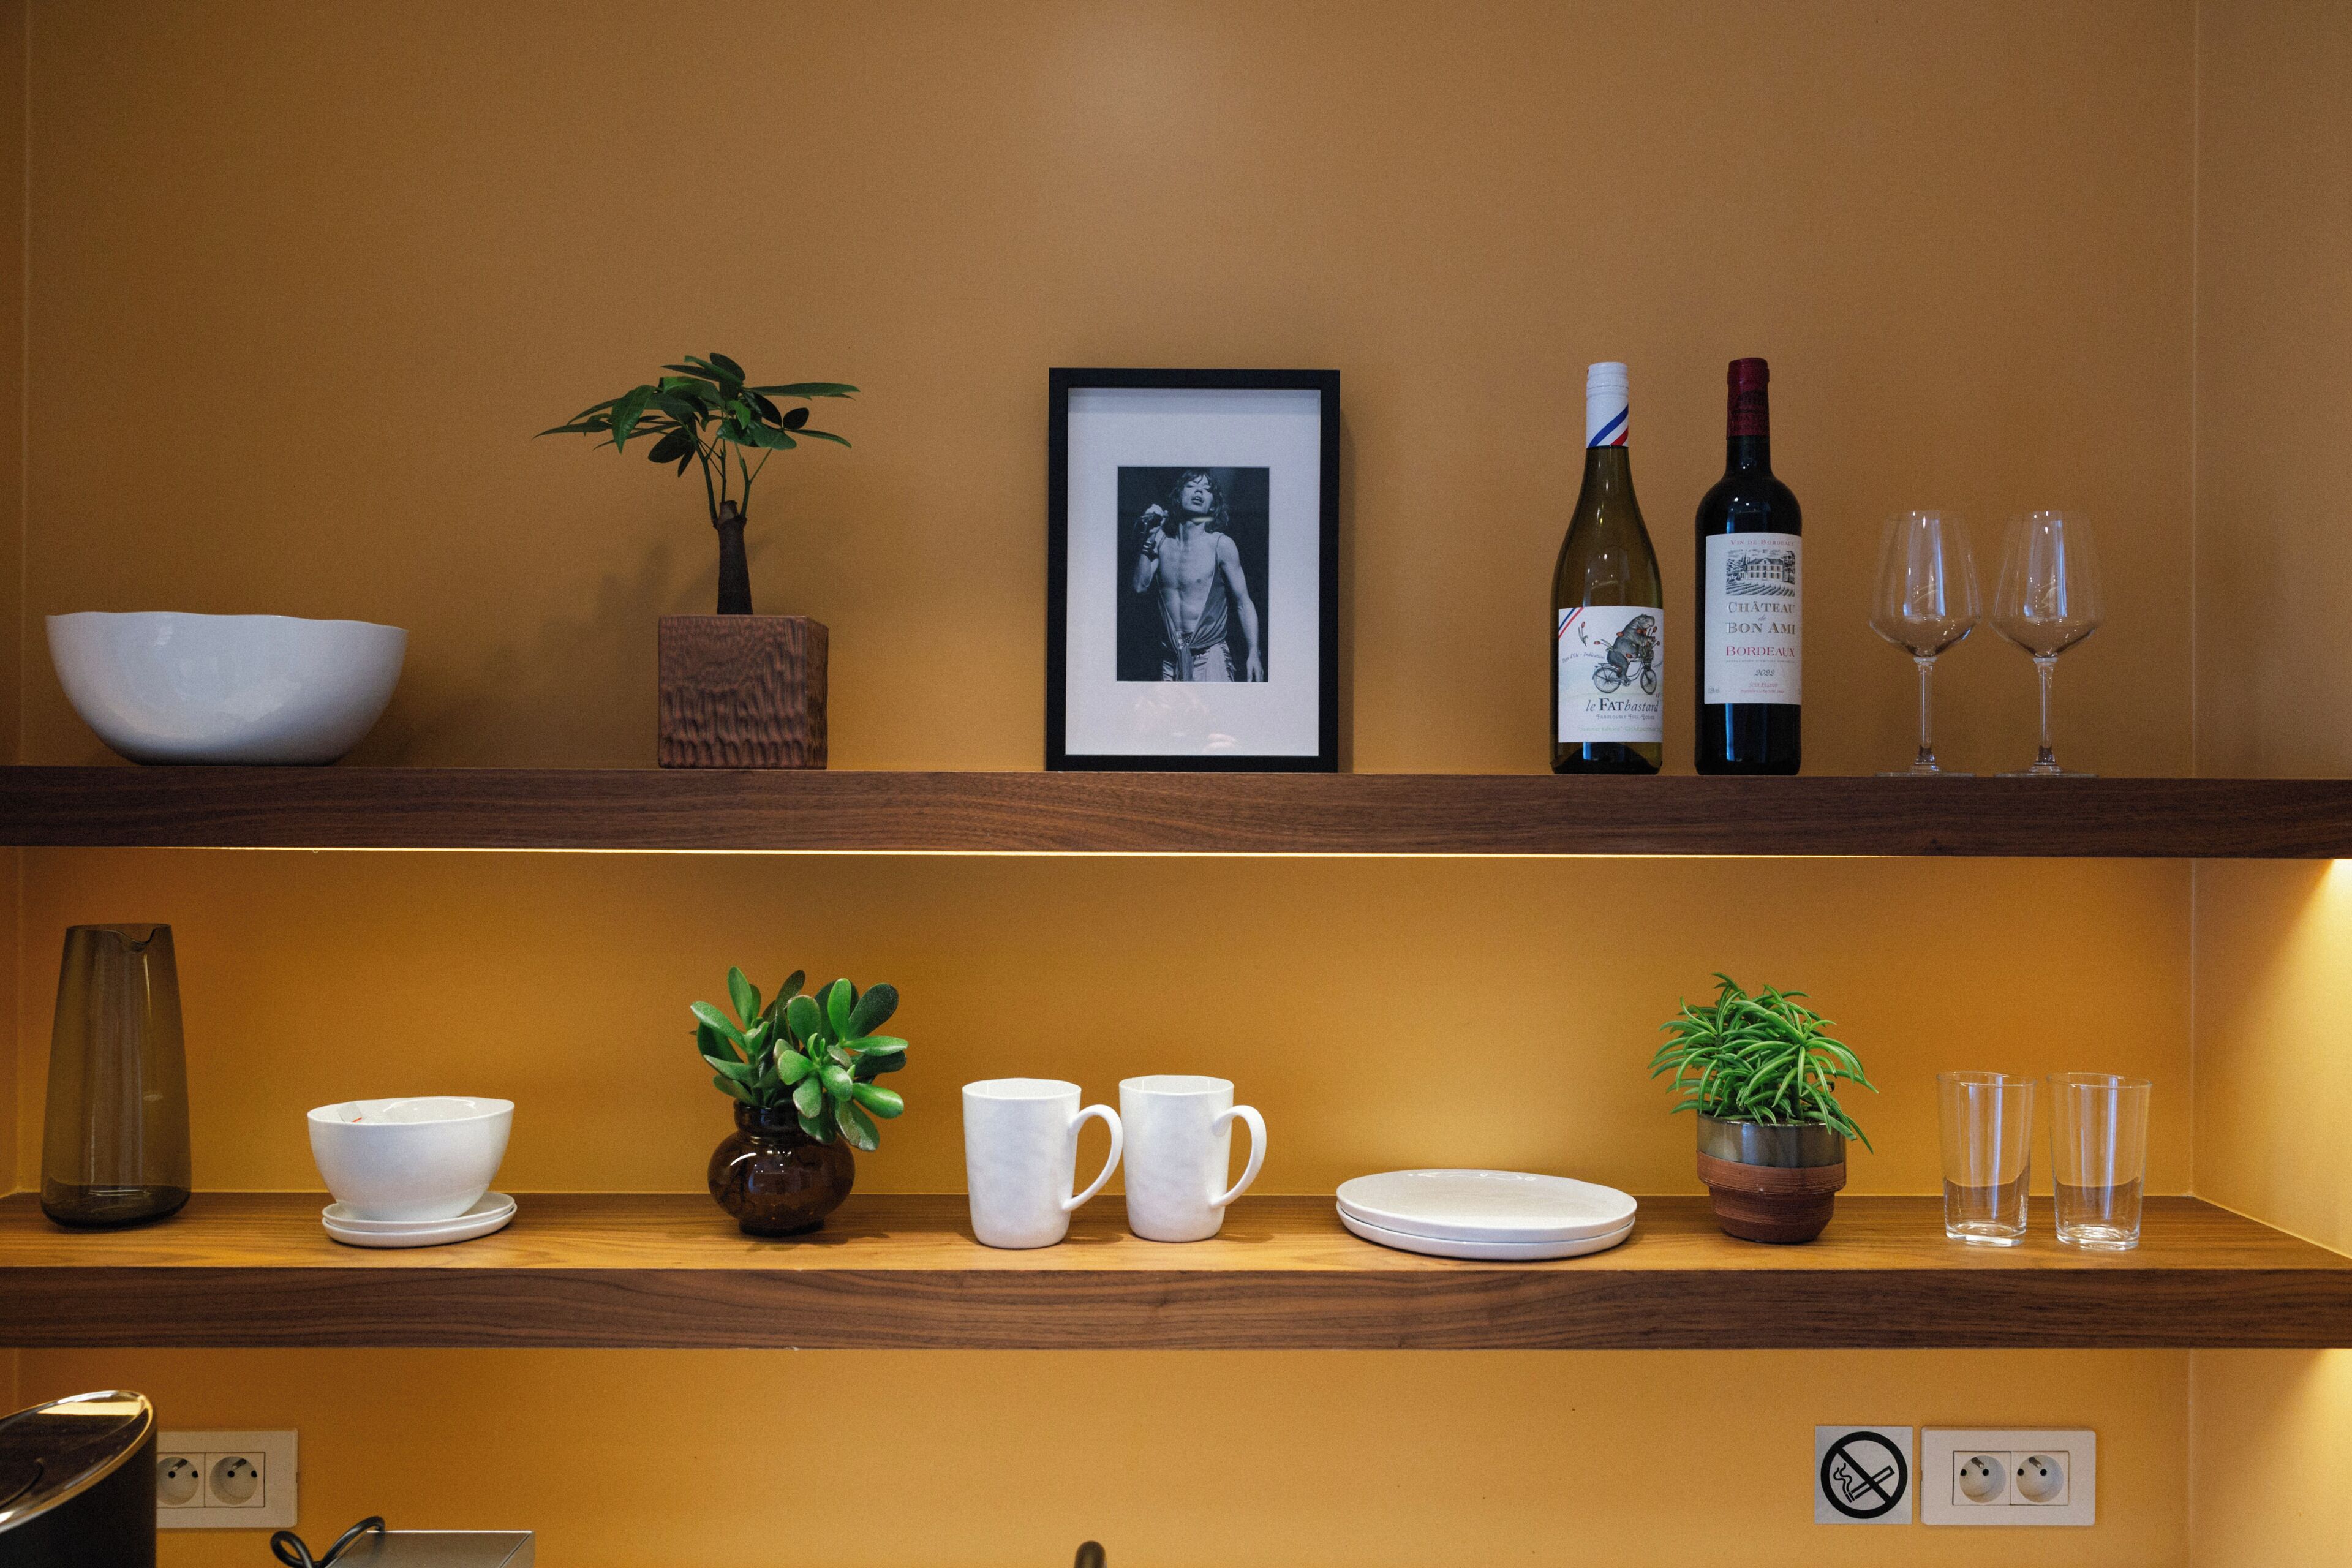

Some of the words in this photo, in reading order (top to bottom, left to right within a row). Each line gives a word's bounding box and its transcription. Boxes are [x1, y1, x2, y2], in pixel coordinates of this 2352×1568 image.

[1727, 601, 1795, 613] CHÂTEAU
[1725, 622, 1762, 635] BON
[1768, 623, 1795, 635] AMI
[1725, 646, 1795, 657] BORDEAUX
[1586, 699, 1596, 712] le
